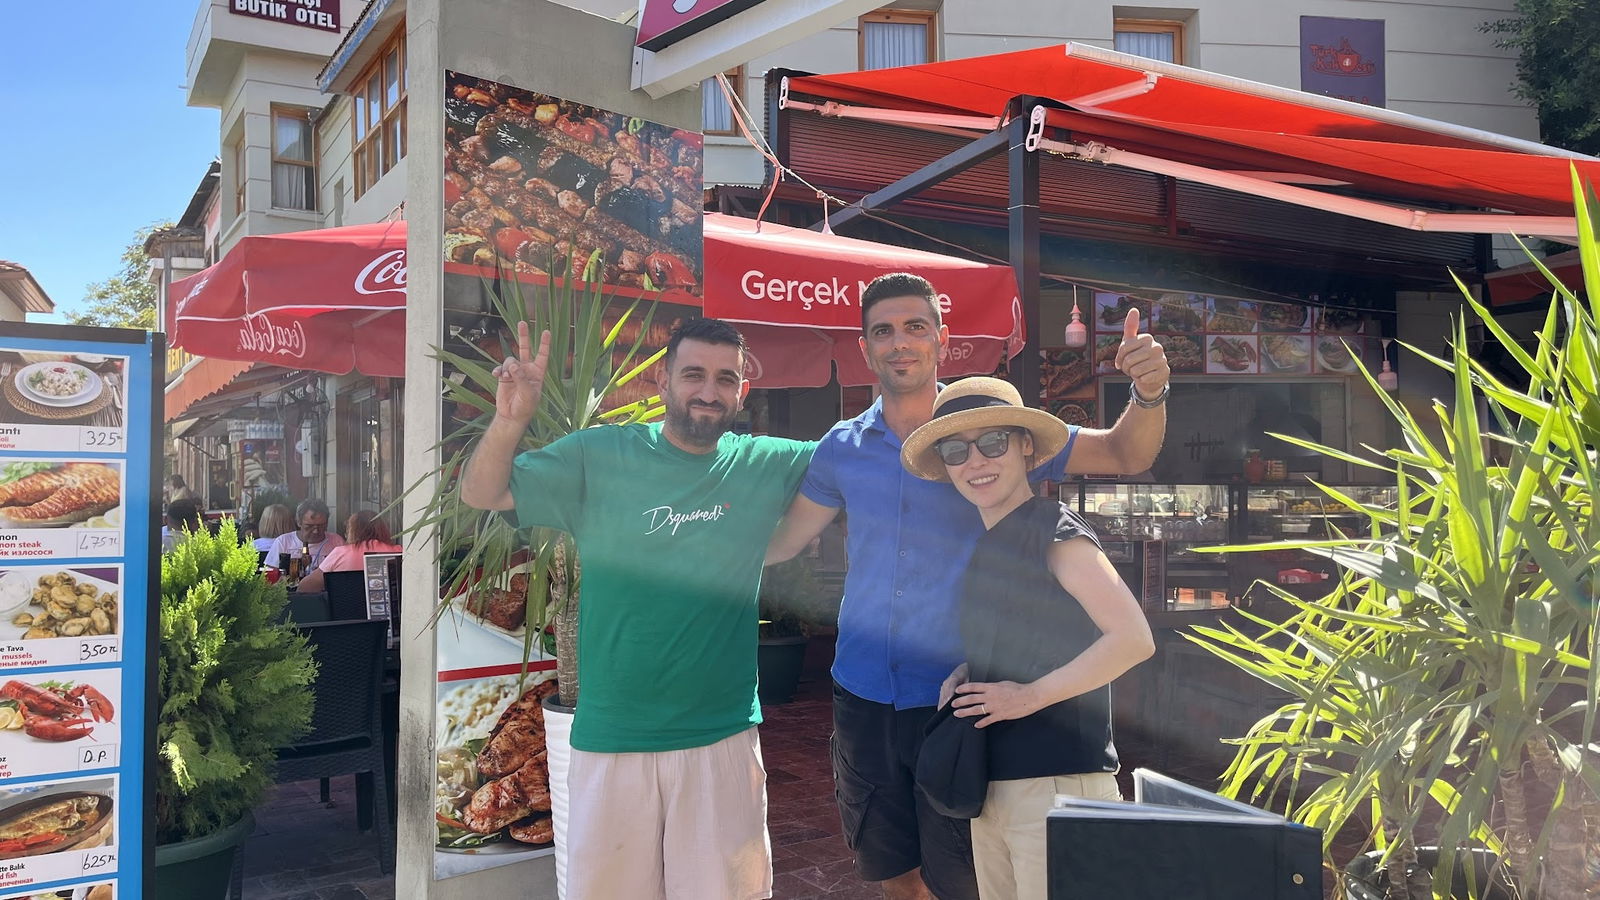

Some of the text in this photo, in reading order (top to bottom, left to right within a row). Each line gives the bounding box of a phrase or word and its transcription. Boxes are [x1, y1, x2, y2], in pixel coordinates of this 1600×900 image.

[235, 0, 337, 28] BUTİK OTEL
[741, 270, 850, 311] Gerçek
[19, 540, 42, 548] steak
[2, 652, 33, 660] mussels
[21, 659, 48, 667] мидии
